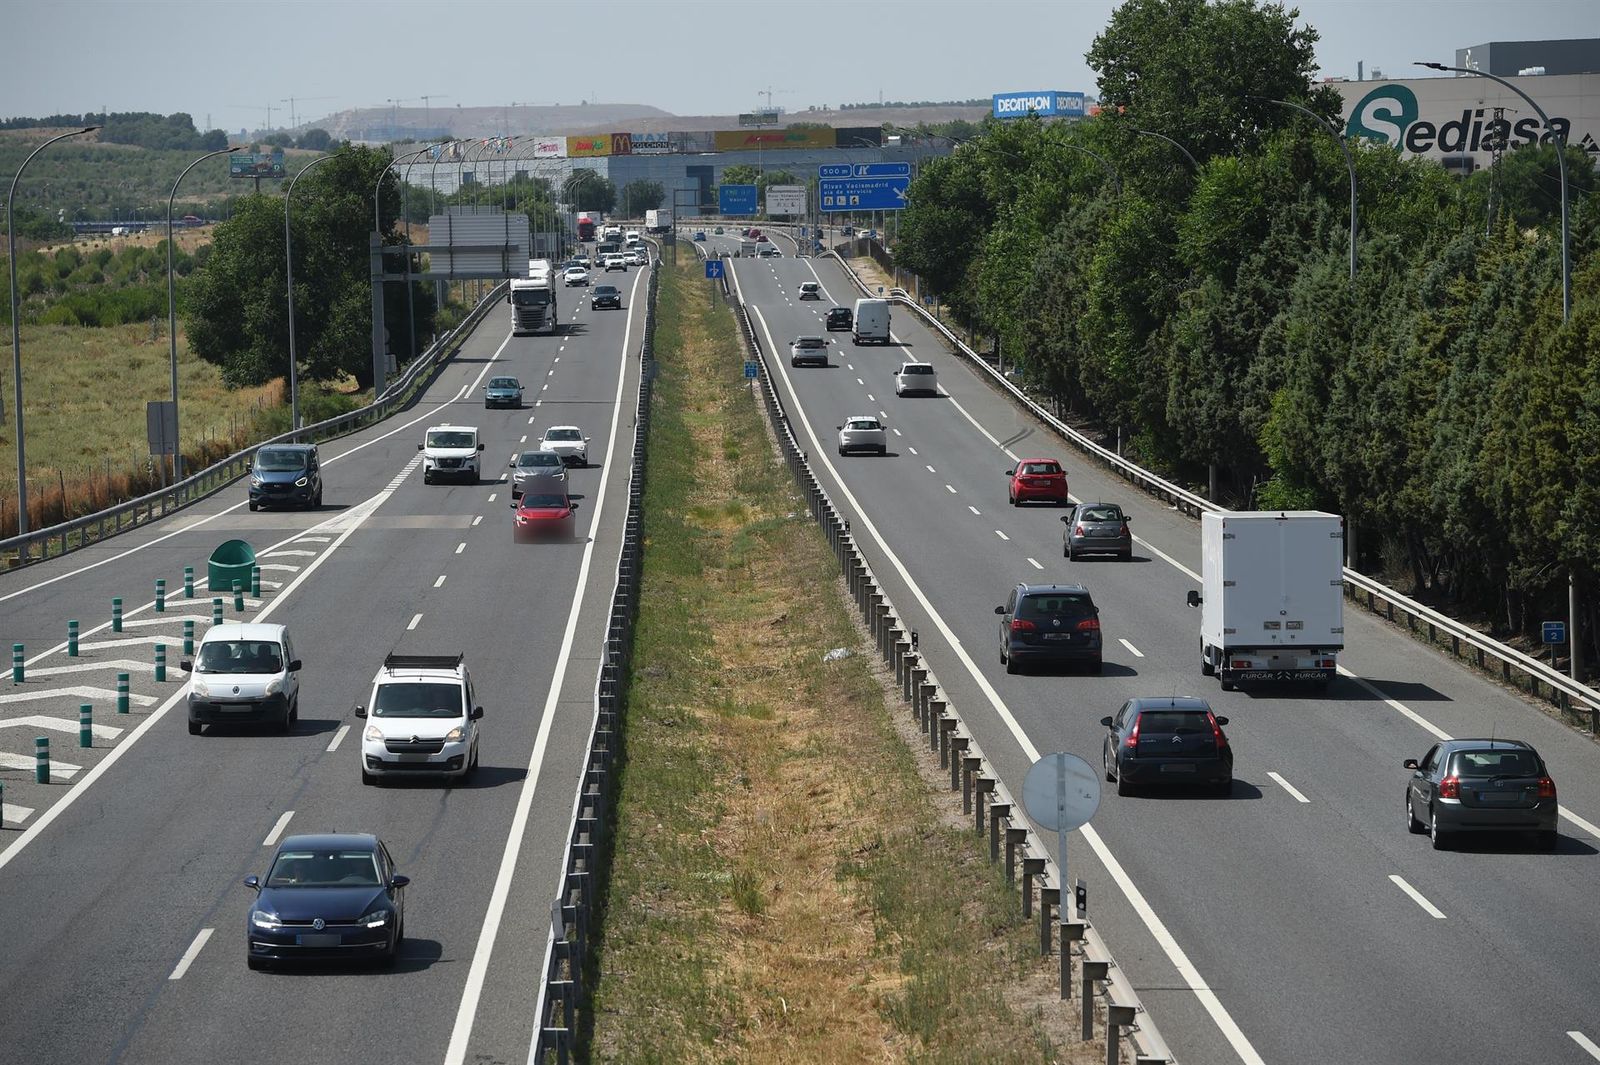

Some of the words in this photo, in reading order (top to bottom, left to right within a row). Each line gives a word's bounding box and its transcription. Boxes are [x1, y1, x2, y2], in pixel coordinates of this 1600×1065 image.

[998, 96, 1050, 112] DECATHLON
[1360, 97, 1571, 152] Sediasa
[632, 133, 667, 141] MAX
[1550, 632, 1558, 640] 2
[1241, 672, 1274, 680] FURCAR
[1295, 672, 1328, 680] FURCAR
